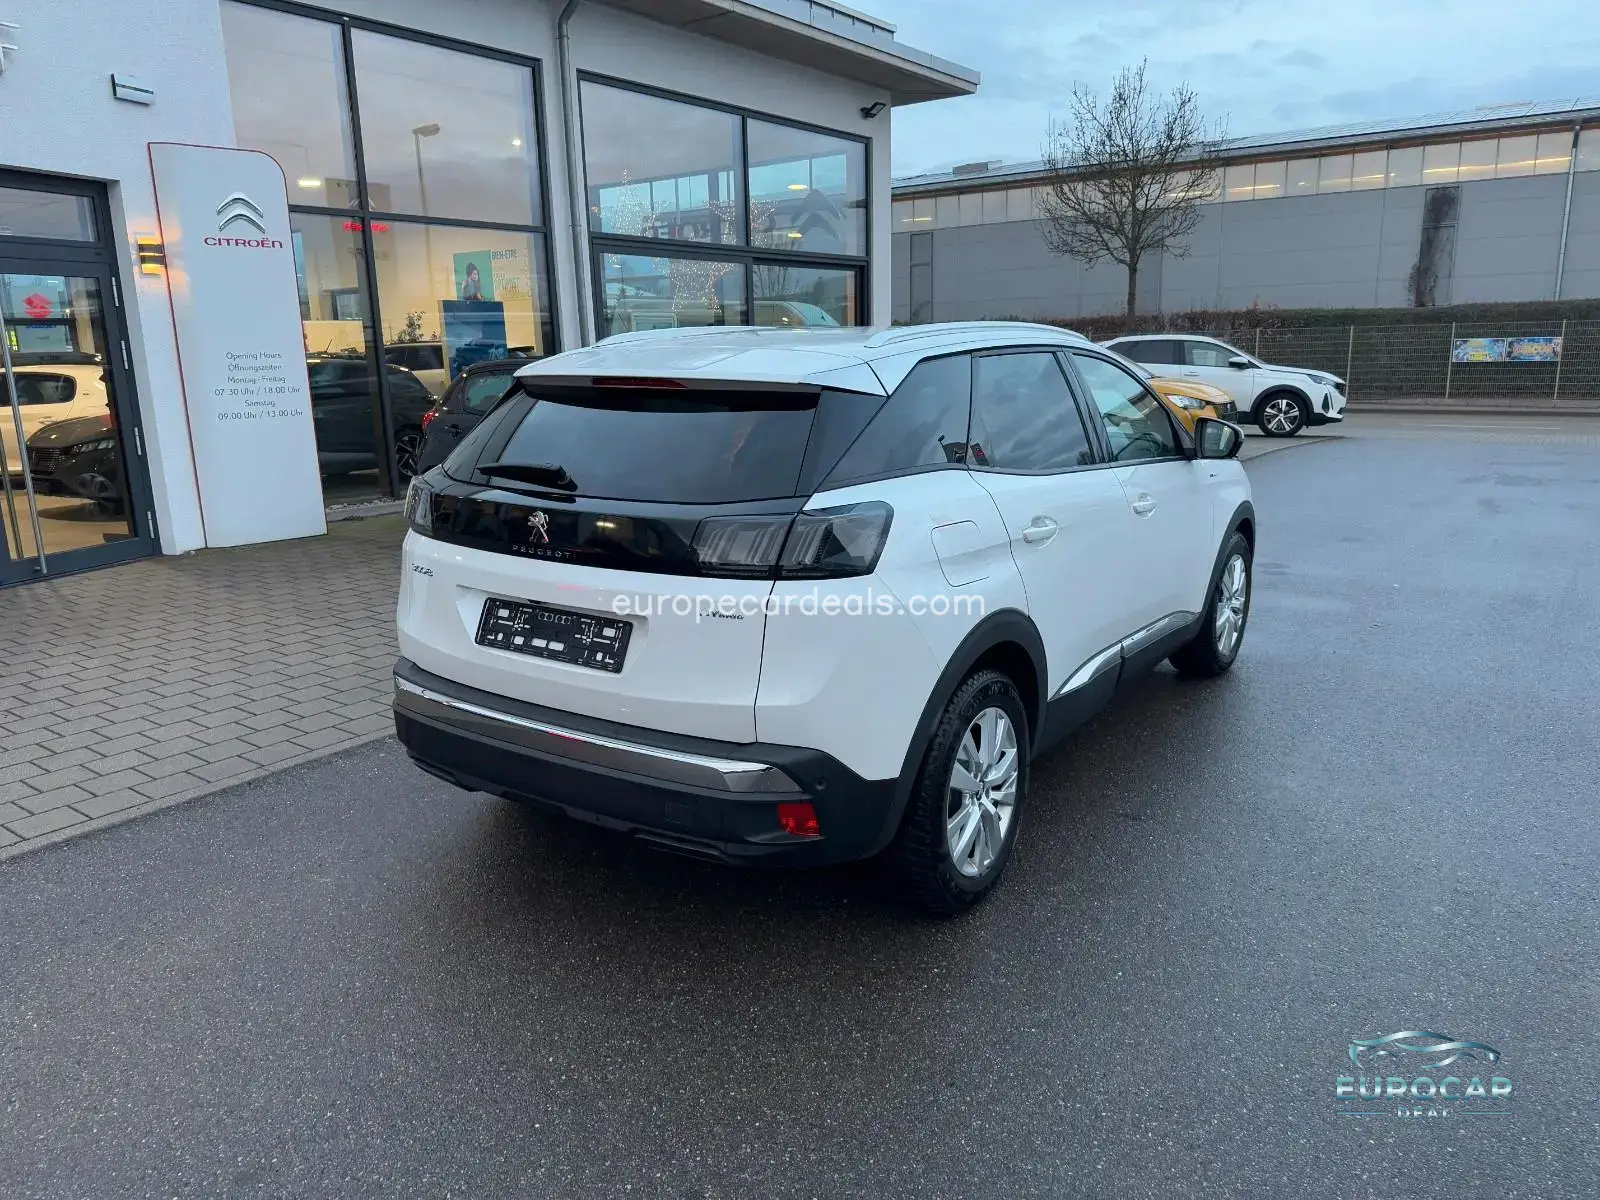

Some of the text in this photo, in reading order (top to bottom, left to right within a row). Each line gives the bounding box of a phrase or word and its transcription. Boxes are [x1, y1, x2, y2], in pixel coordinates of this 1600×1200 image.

[226, 351, 258, 361] Opening
[227, 363, 282, 373] Öffnungszeiten
[227, 376, 256, 385] Montag
[261, 375, 286, 384] Freitag
[240, 387, 255, 396] Uhr
[244, 399, 276, 408] Samstag
[243, 411, 257, 419] Uhr
[290, 409, 304, 417] Uhr
[512, 544, 572, 559] PEUGEOT
